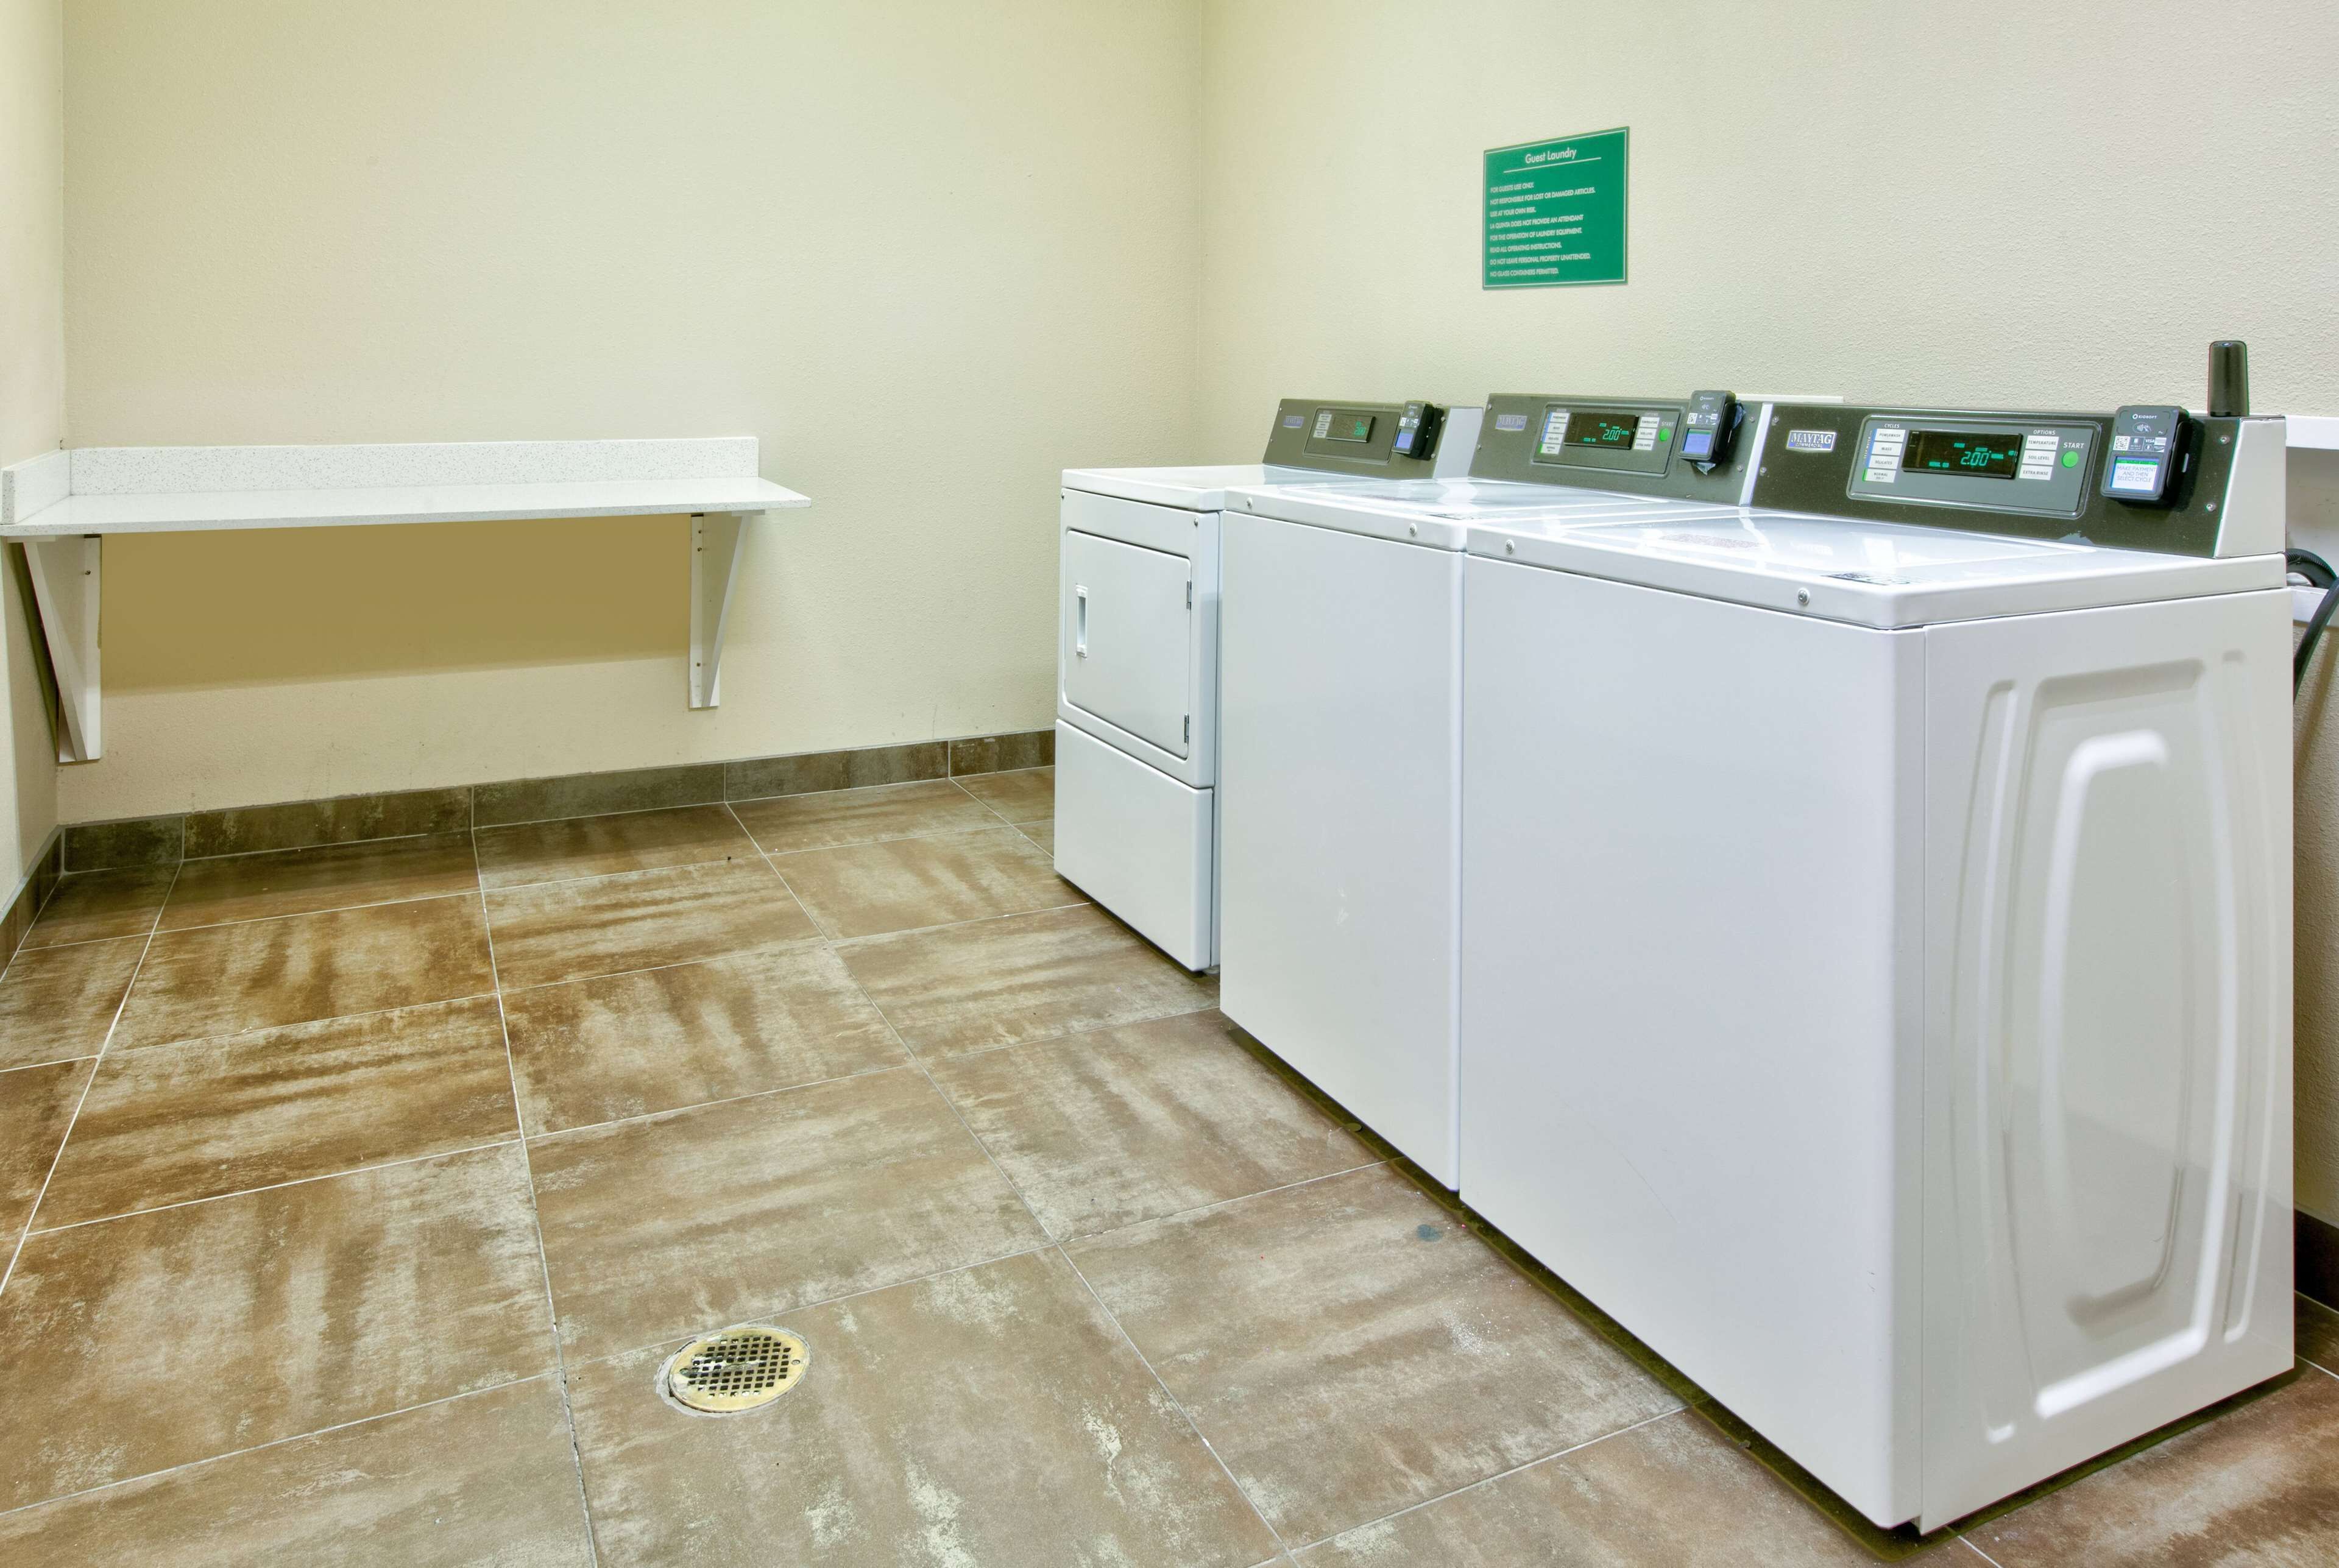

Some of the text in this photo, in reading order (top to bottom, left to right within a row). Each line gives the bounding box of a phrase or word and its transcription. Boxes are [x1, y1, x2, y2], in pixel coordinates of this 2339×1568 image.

[1525, 147, 1577, 164] Guest Laundry
[1552, 189, 1574, 198] DAMAGED
[1574, 186, 1596, 195] ARTICLES.
[1791, 433, 1832, 444] MAYTAG
[1960, 451, 1990, 467] 2.00
